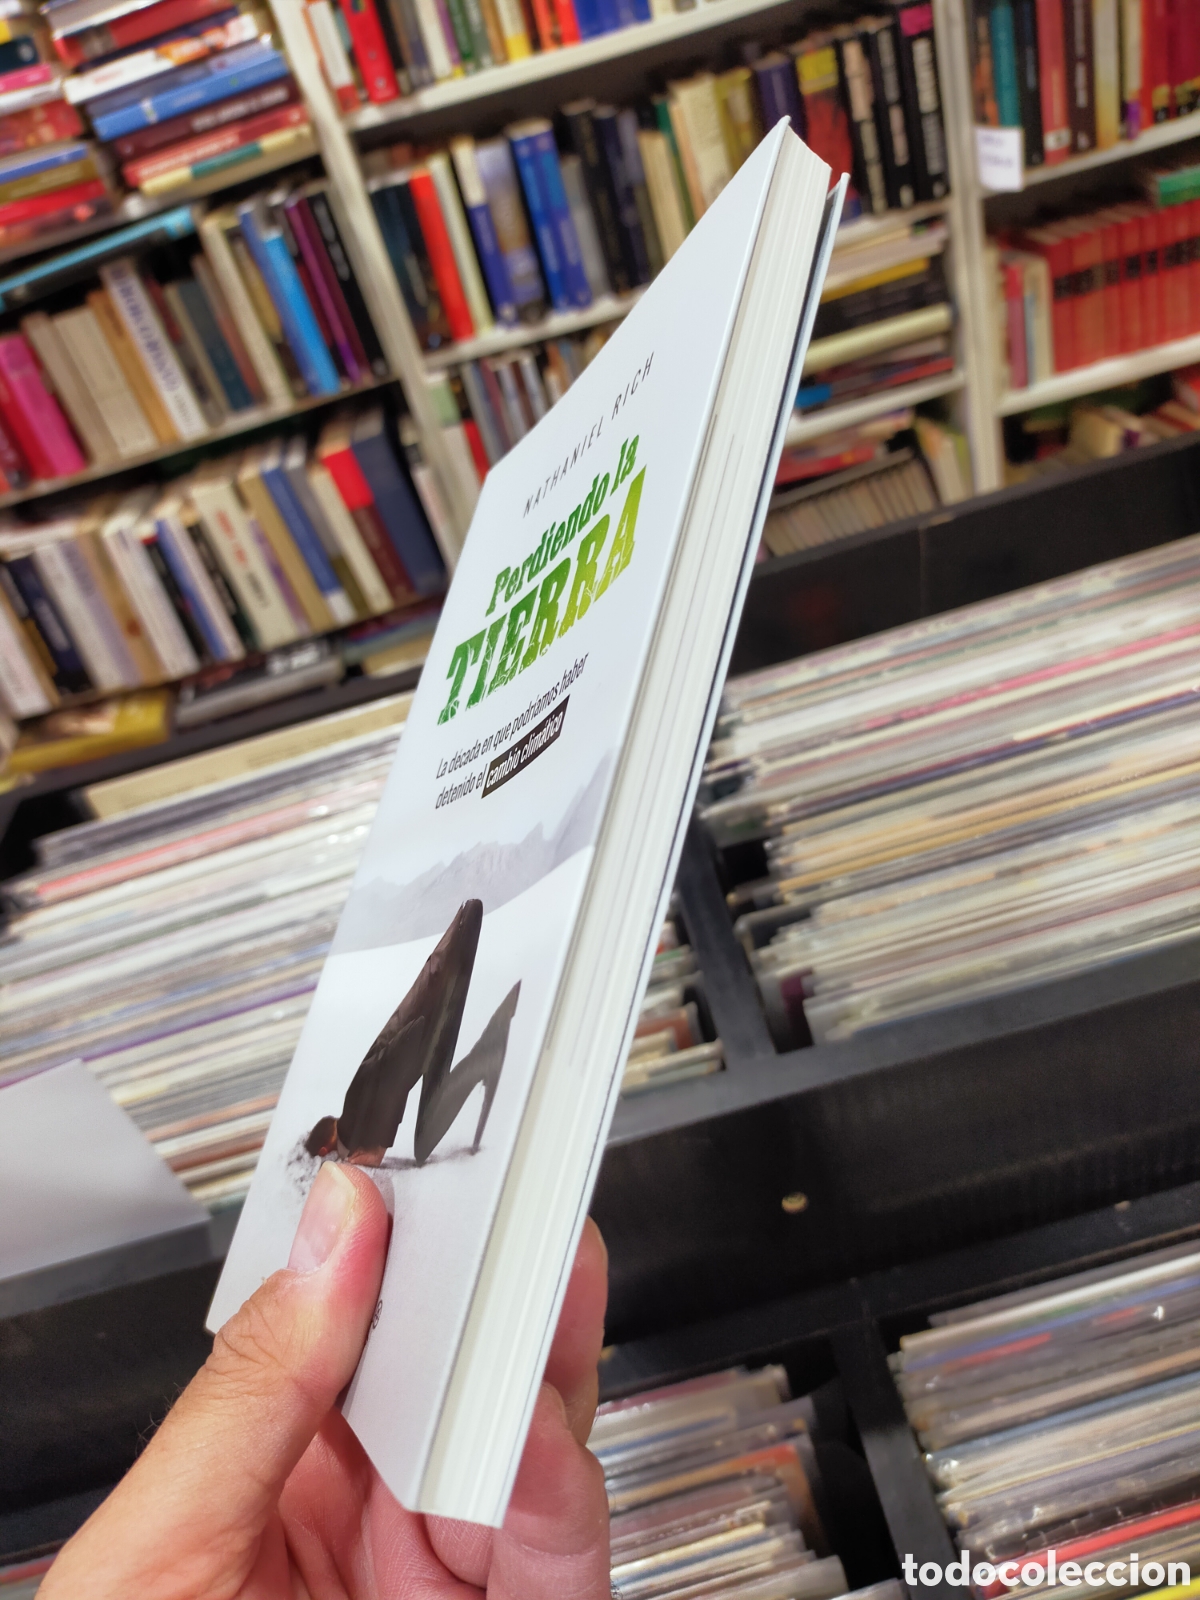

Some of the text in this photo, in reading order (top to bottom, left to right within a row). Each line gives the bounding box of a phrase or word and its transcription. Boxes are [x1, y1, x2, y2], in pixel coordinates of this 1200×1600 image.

[523, 351, 654, 518] NATHANIEL RICH
[437, 464, 647, 726] TIERRA
[485, 434, 639, 617] Perdiendo la
[435, 711, 564, 809] detenido el cambio climático
[436, 652, 589, 779] La década en que podríamos haber
